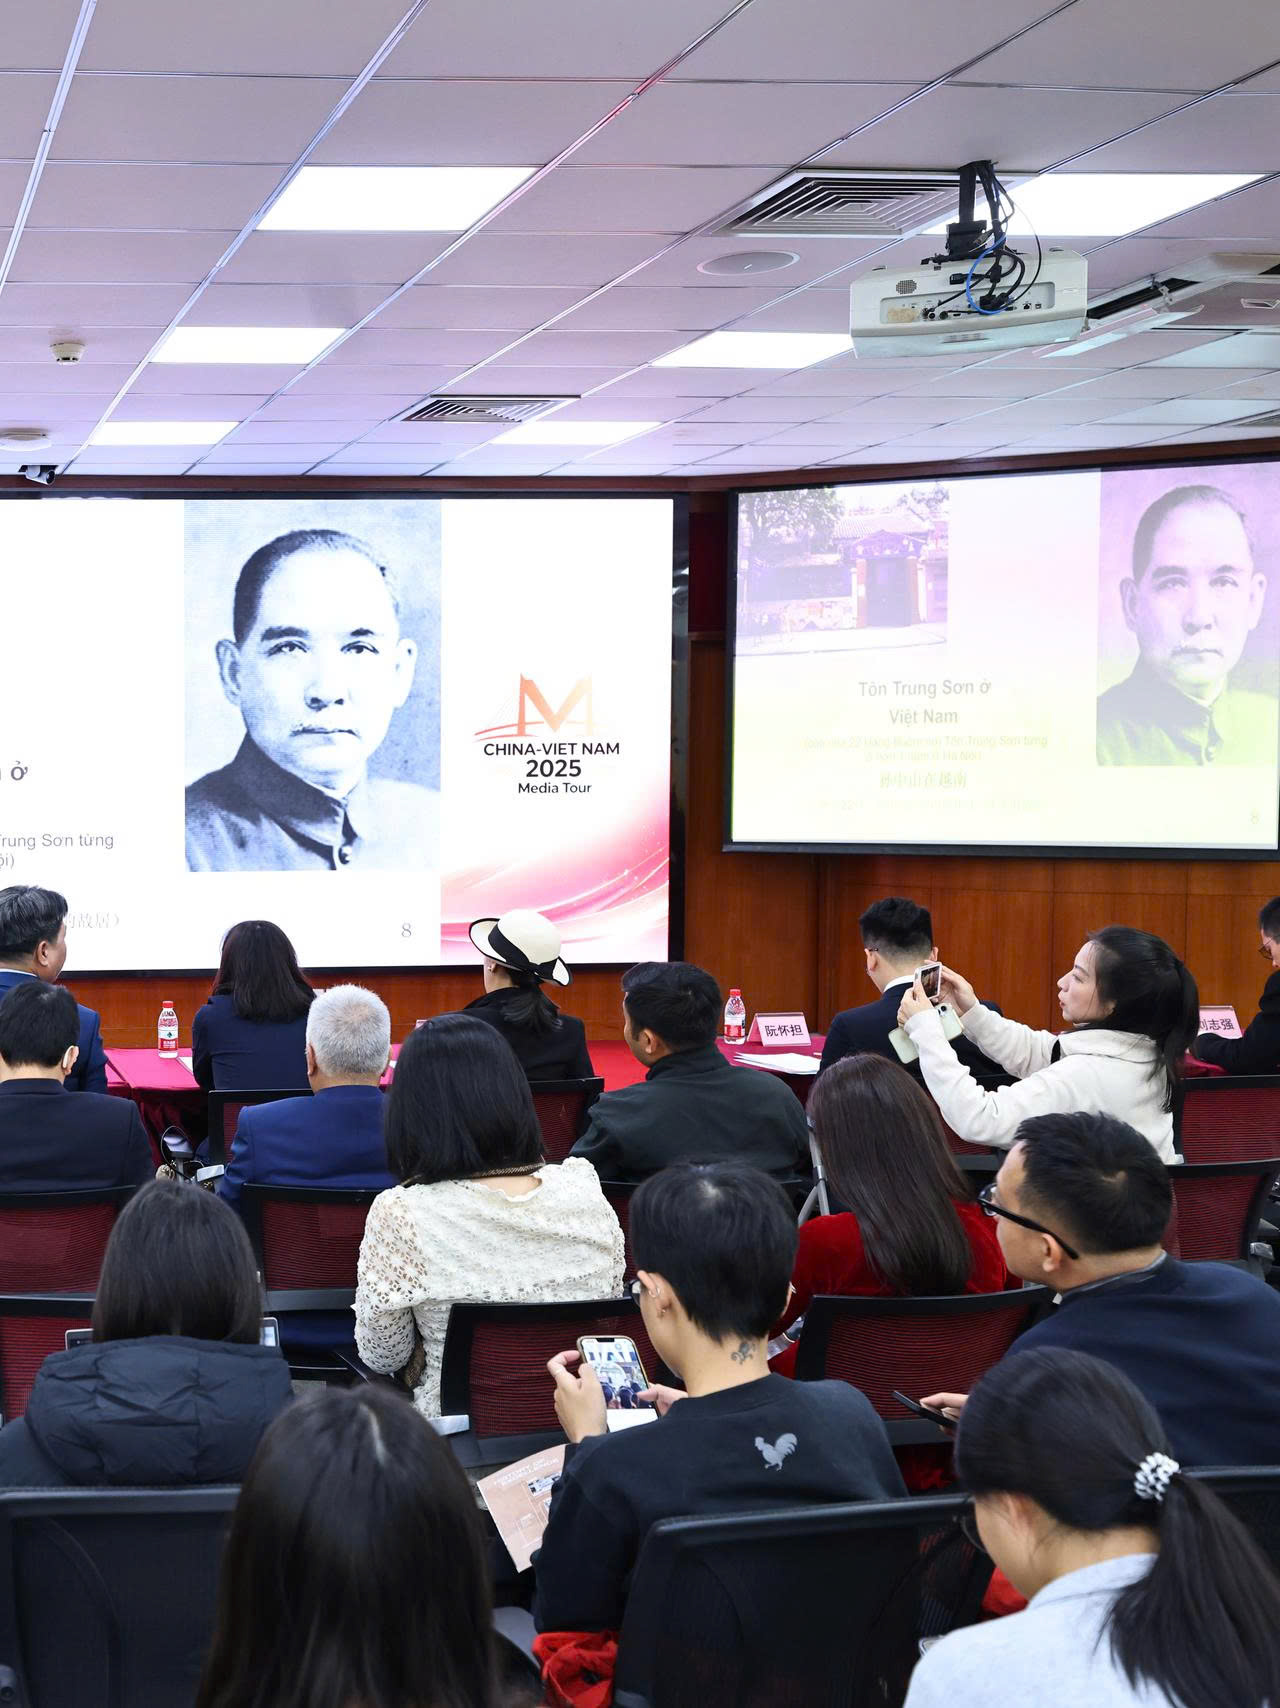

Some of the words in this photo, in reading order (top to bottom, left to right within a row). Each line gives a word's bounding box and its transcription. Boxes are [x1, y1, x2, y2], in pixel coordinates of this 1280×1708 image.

[858, 680, 887, 697] Tôn
[893, 680, 937, 699] Trung
[942, 679, 974, 695] Sơn
[889, 708, 918, 728] Việt
[923, 708, 959, 724] Nam
[483, 743, 578, 756] CHINA-VIET
[582, 742, 620, 755] NAM
[10, 760, 28, 781] ở
[525, 759, 582, 778] 2025
[518, 782, 559, 794] Media
[563, 782, 592, 793] Tour
[41, 833, 74, 848] Sơn
[79, 833, 114, 850] từng
[401, 923, 412, 938] 8
[764, 1024, 804, 1037] 阮怀担
